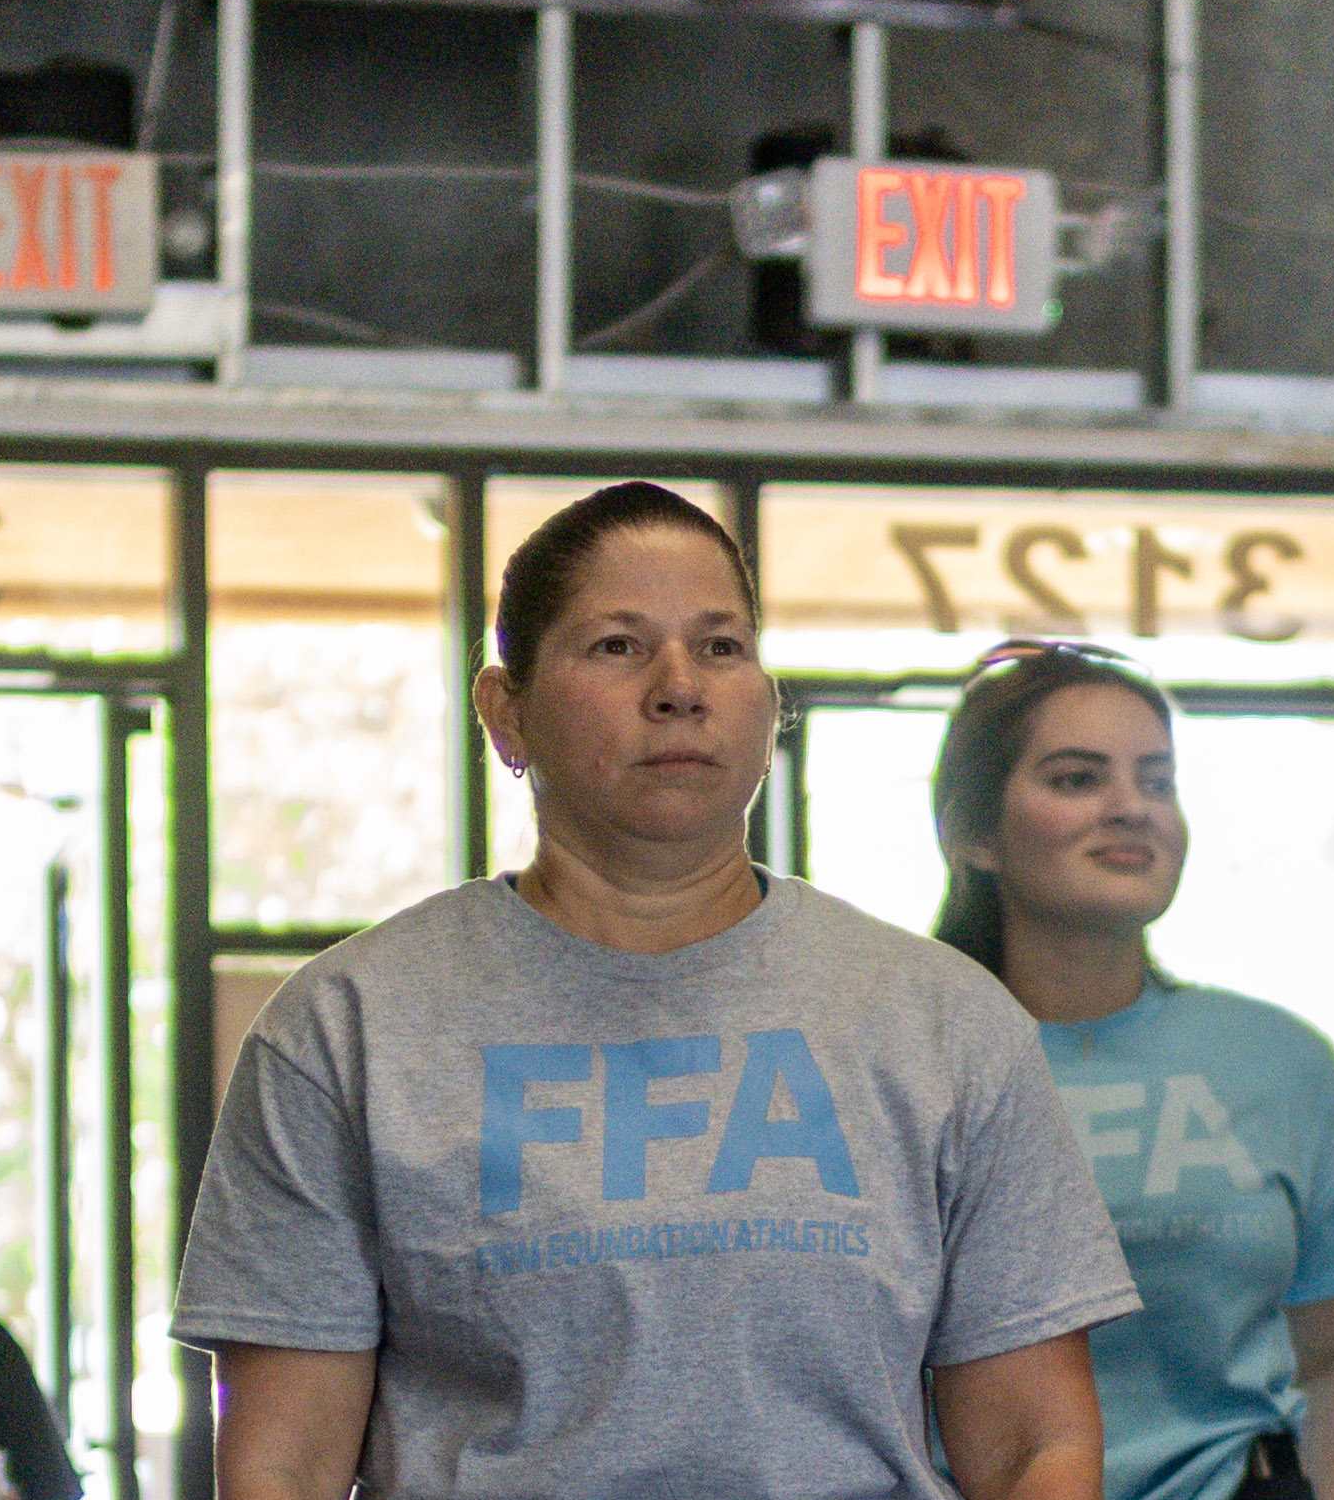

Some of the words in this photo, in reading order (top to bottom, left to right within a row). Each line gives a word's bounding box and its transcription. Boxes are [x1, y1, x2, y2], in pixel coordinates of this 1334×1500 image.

[855, 167, 1027, 308] EXIT
[479, 1028, 861, 1218] FFA
[477, 1240, 540, 1277] FIRM
[547, 1219, 730, 1268] FOUNDATION
[736, 1217, 868, 1258] ATHLETICS
